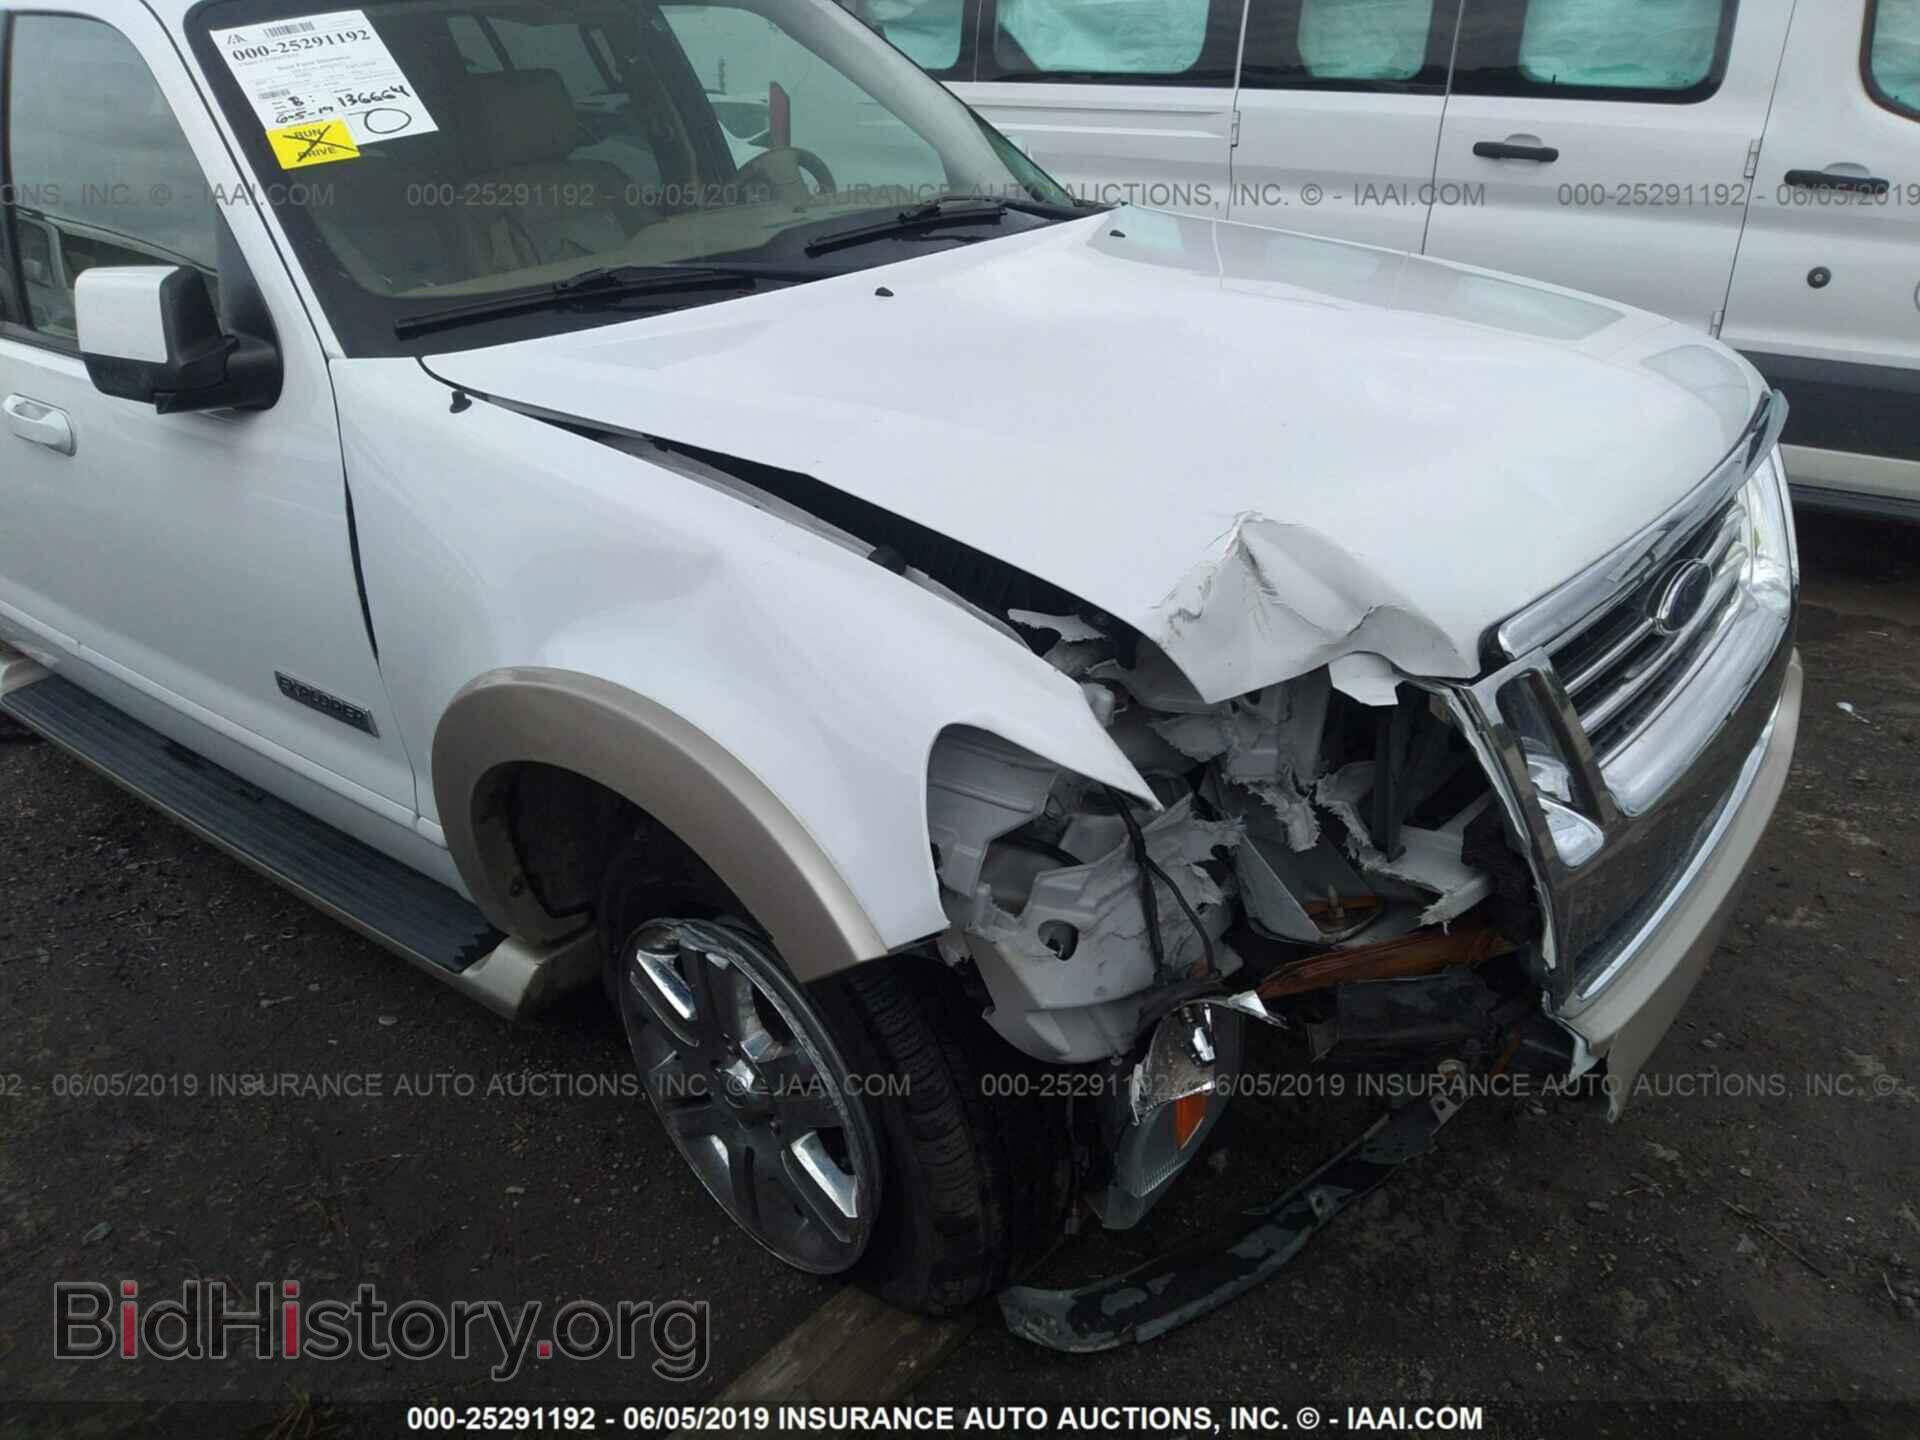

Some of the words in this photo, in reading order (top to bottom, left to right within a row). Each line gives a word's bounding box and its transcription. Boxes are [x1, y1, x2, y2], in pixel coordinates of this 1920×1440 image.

[232, 29, 371, 61] 000-25291192
[294, 128, 322, 140] RUN
[277, 673, 372, 729] EXPLORER
